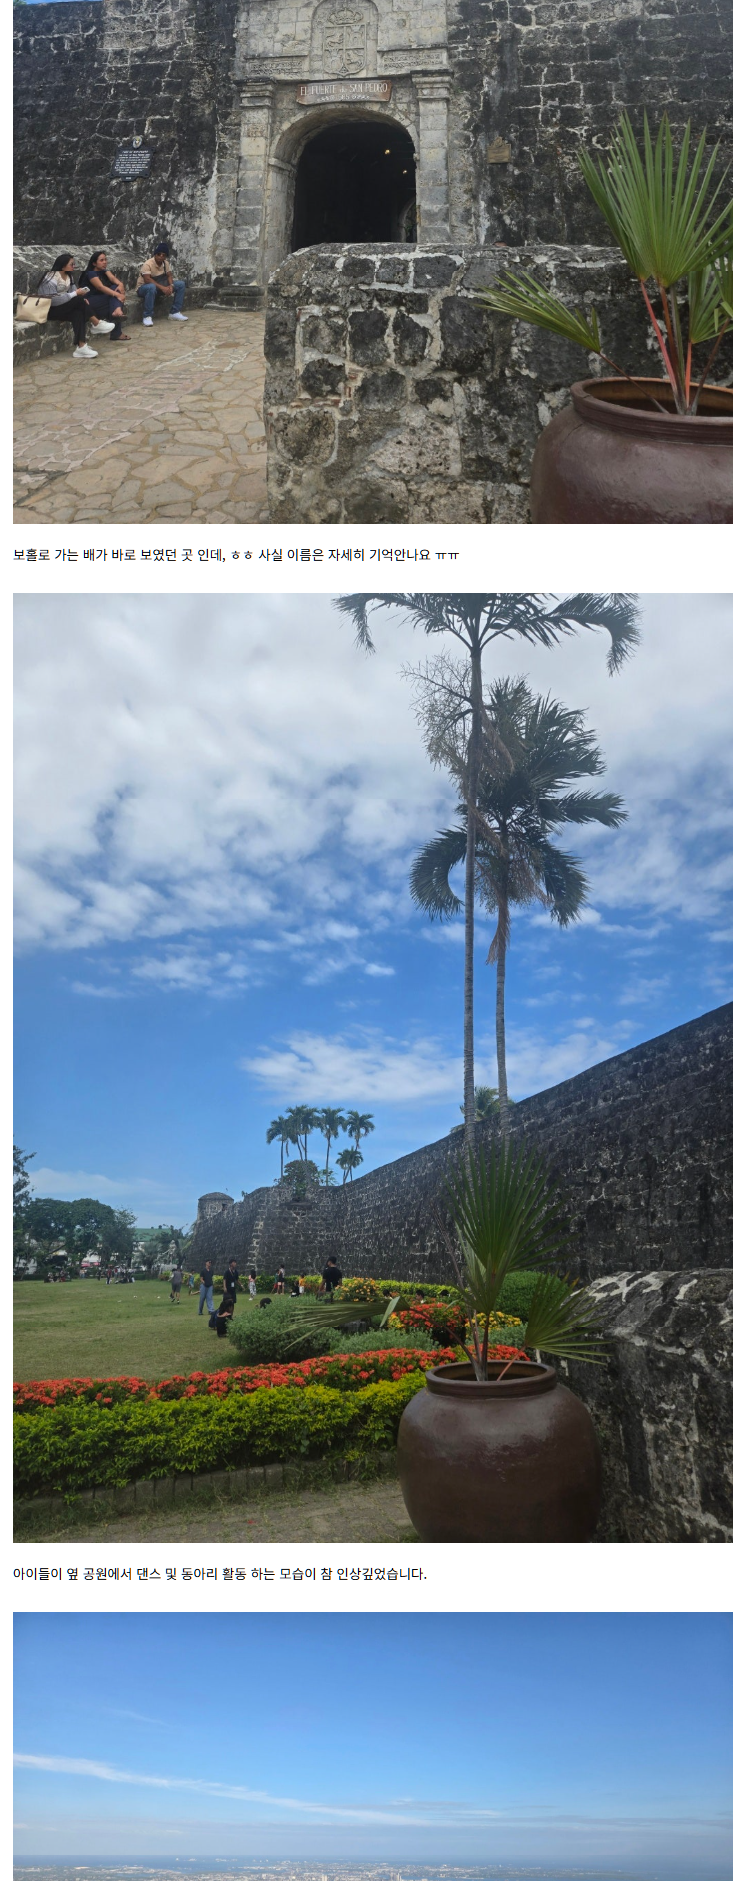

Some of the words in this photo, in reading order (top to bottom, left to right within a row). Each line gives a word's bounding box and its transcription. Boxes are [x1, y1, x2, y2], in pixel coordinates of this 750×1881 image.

[300, 86, 307, 96] EL
[311, 85, 336, 94] FUERTE
[350, 83, 363, 92] SAN
[366, 83, 388, 92] PEDRO
